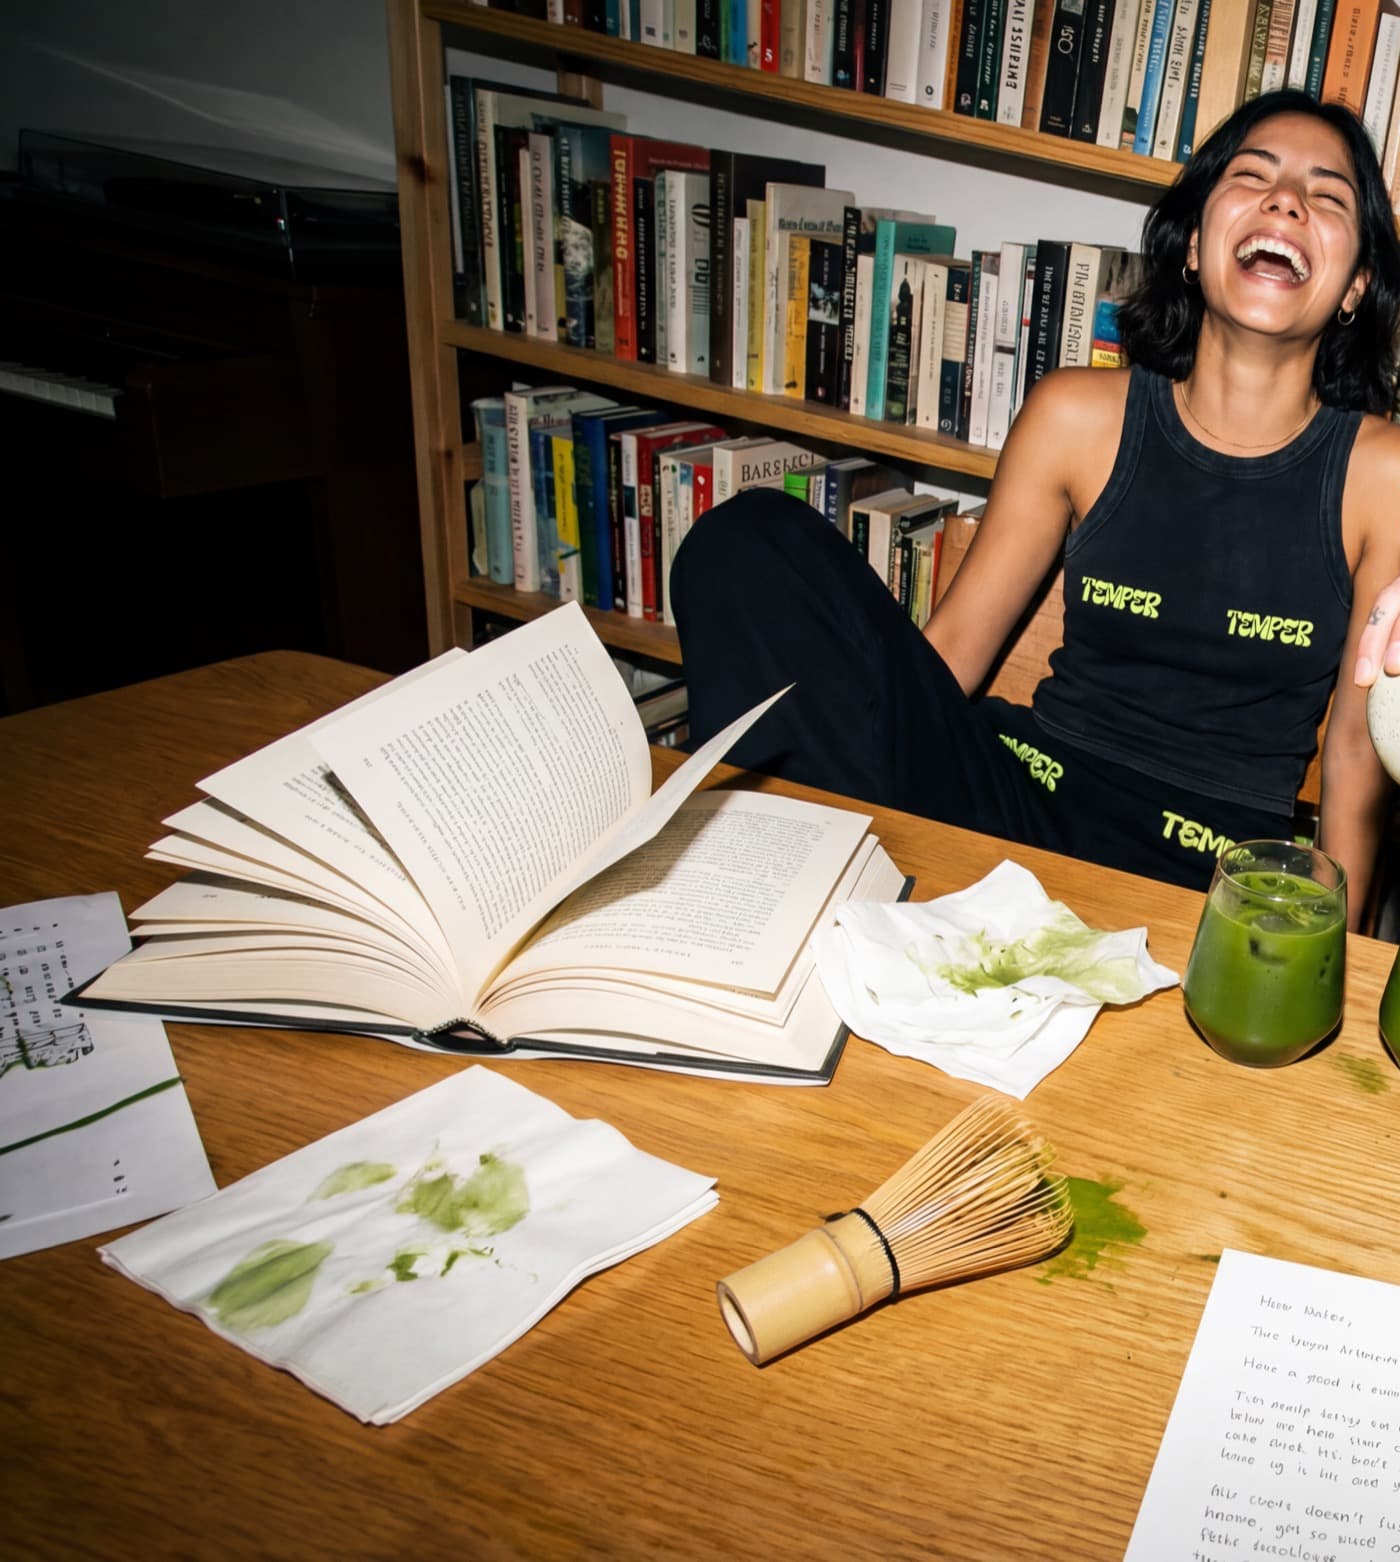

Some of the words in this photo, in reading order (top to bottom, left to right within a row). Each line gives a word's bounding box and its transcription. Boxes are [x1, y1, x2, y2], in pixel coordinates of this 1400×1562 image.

[1081, 576, 1163, 619] TEMPER
[1226, 609, 1315, 648] TEMPER
[1309, 1529, 1328, 1541] so
